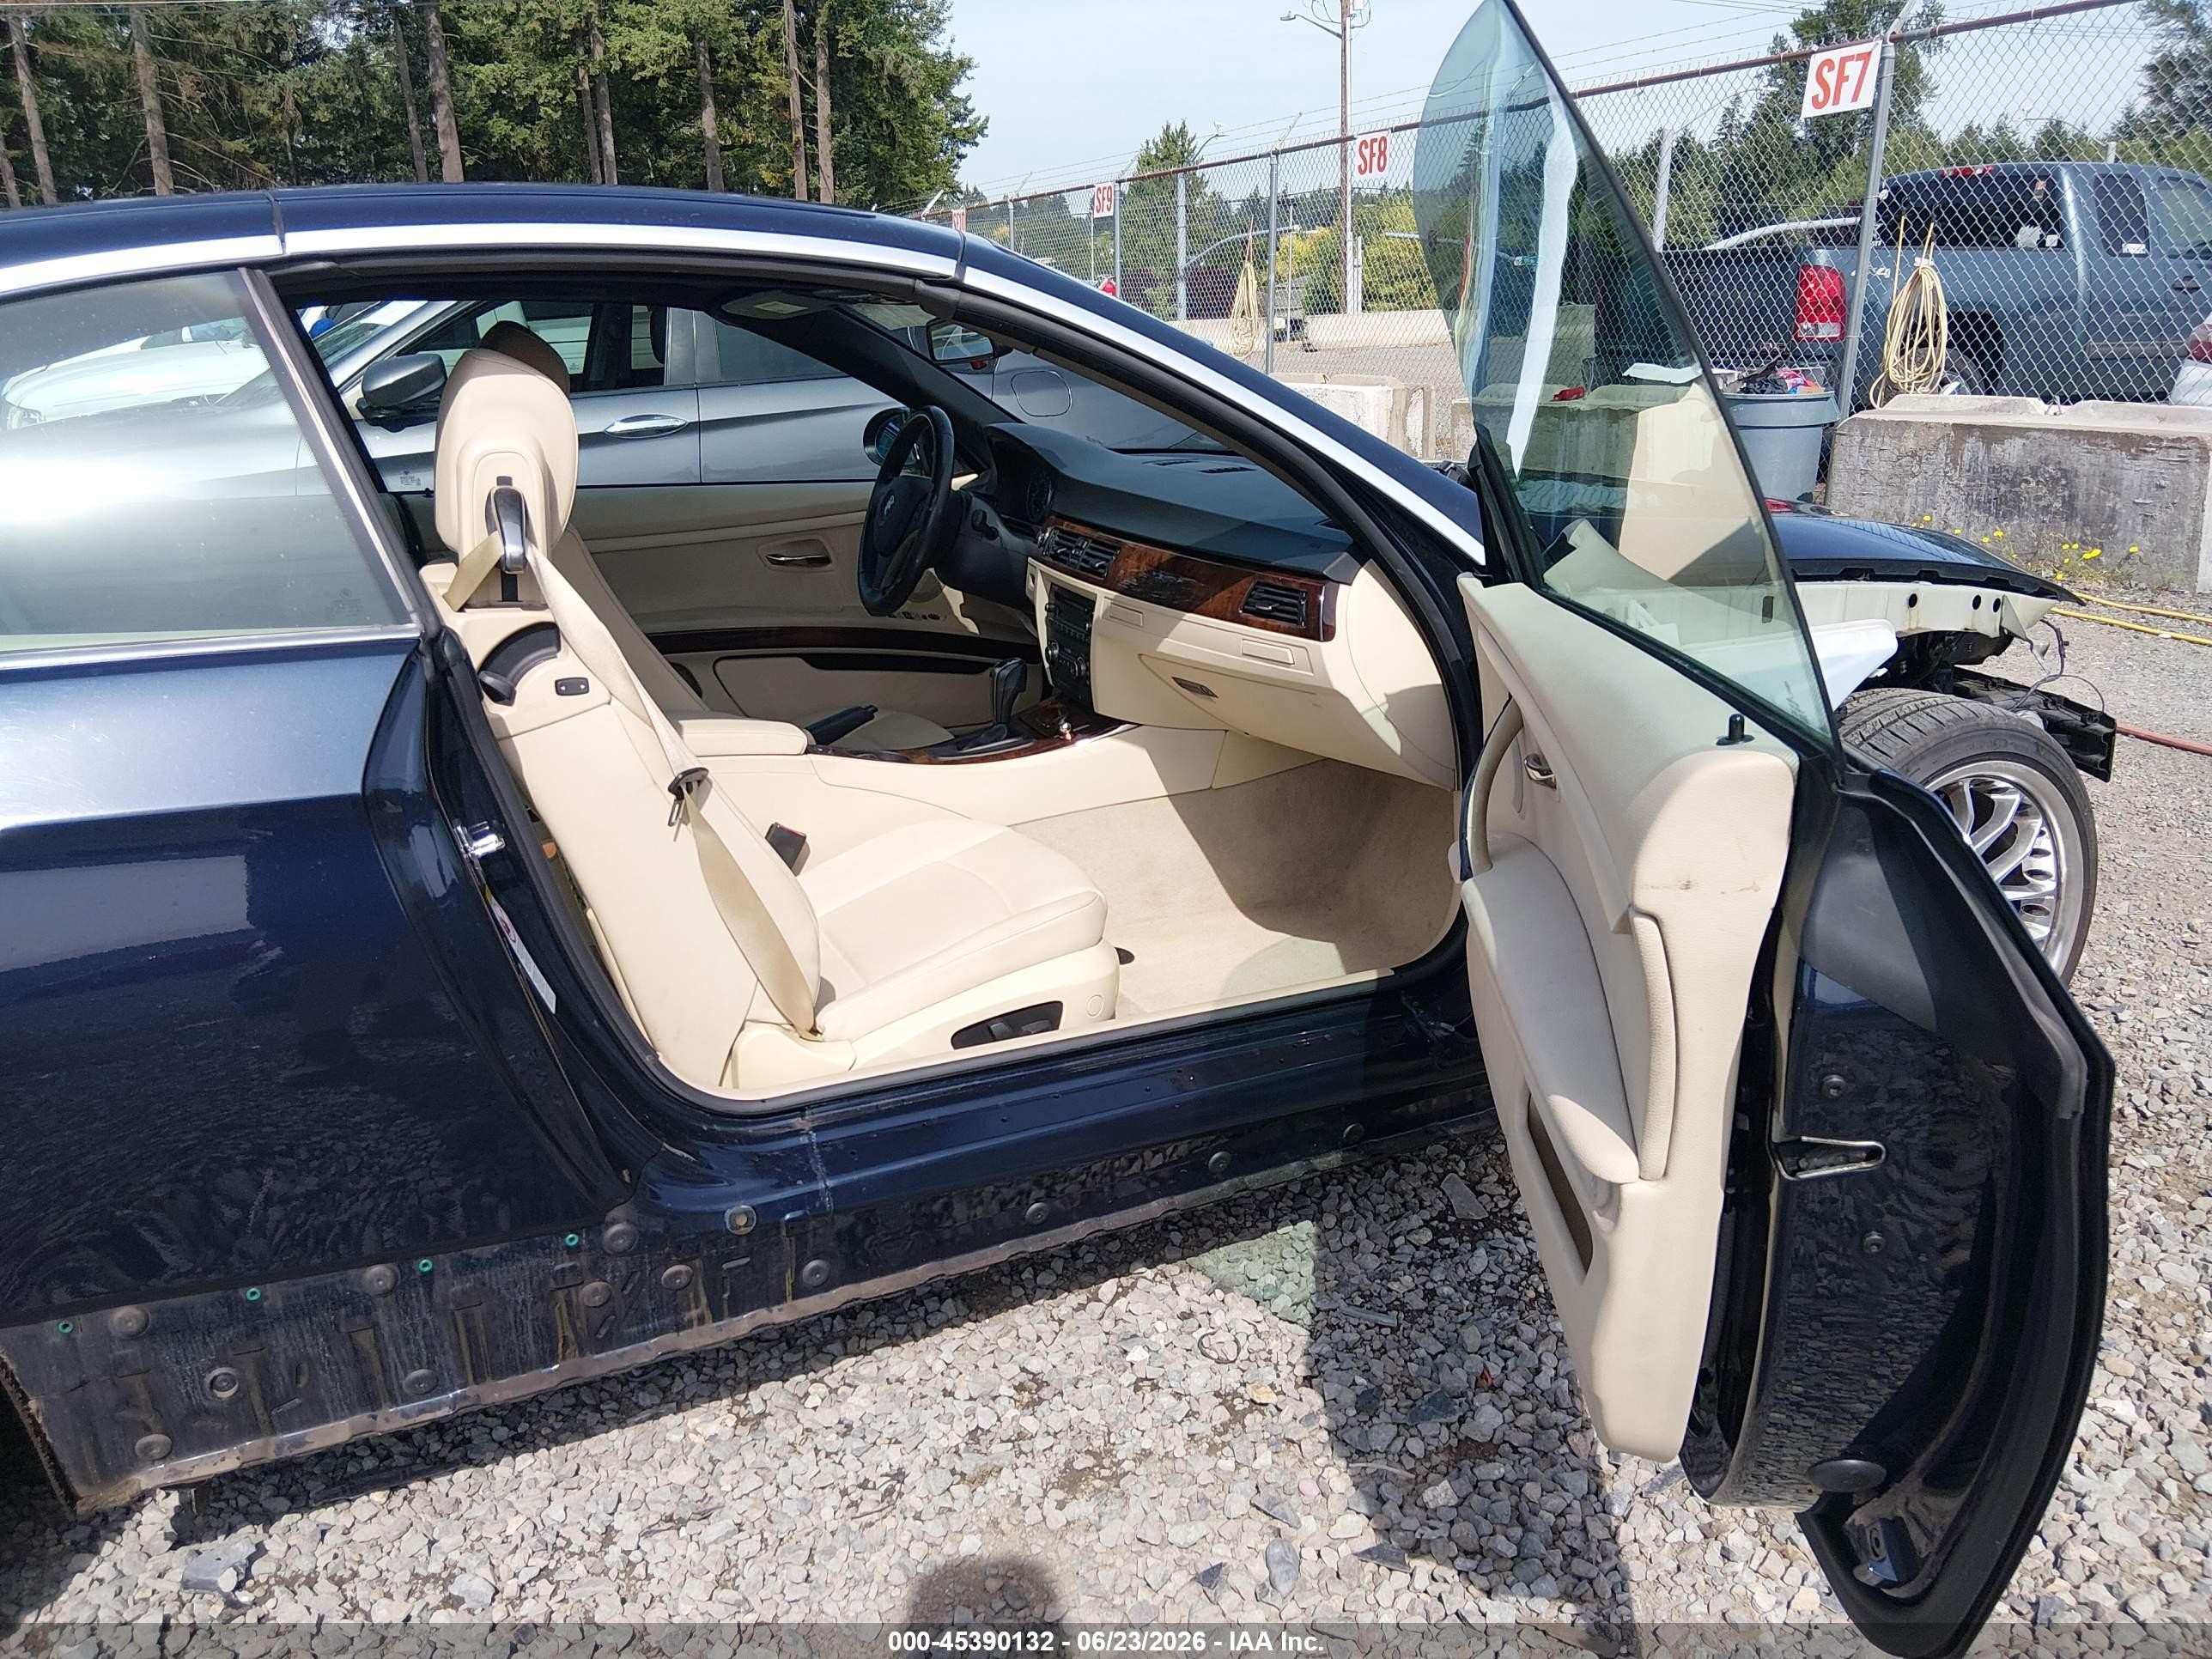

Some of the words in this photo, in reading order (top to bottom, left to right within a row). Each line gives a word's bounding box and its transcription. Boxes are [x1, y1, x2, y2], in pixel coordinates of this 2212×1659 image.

[1812, 52, 1871, 110] SF7
[1358, 136, 1388, 175] SF8
[1096, 185, 1113, 214] SF9
